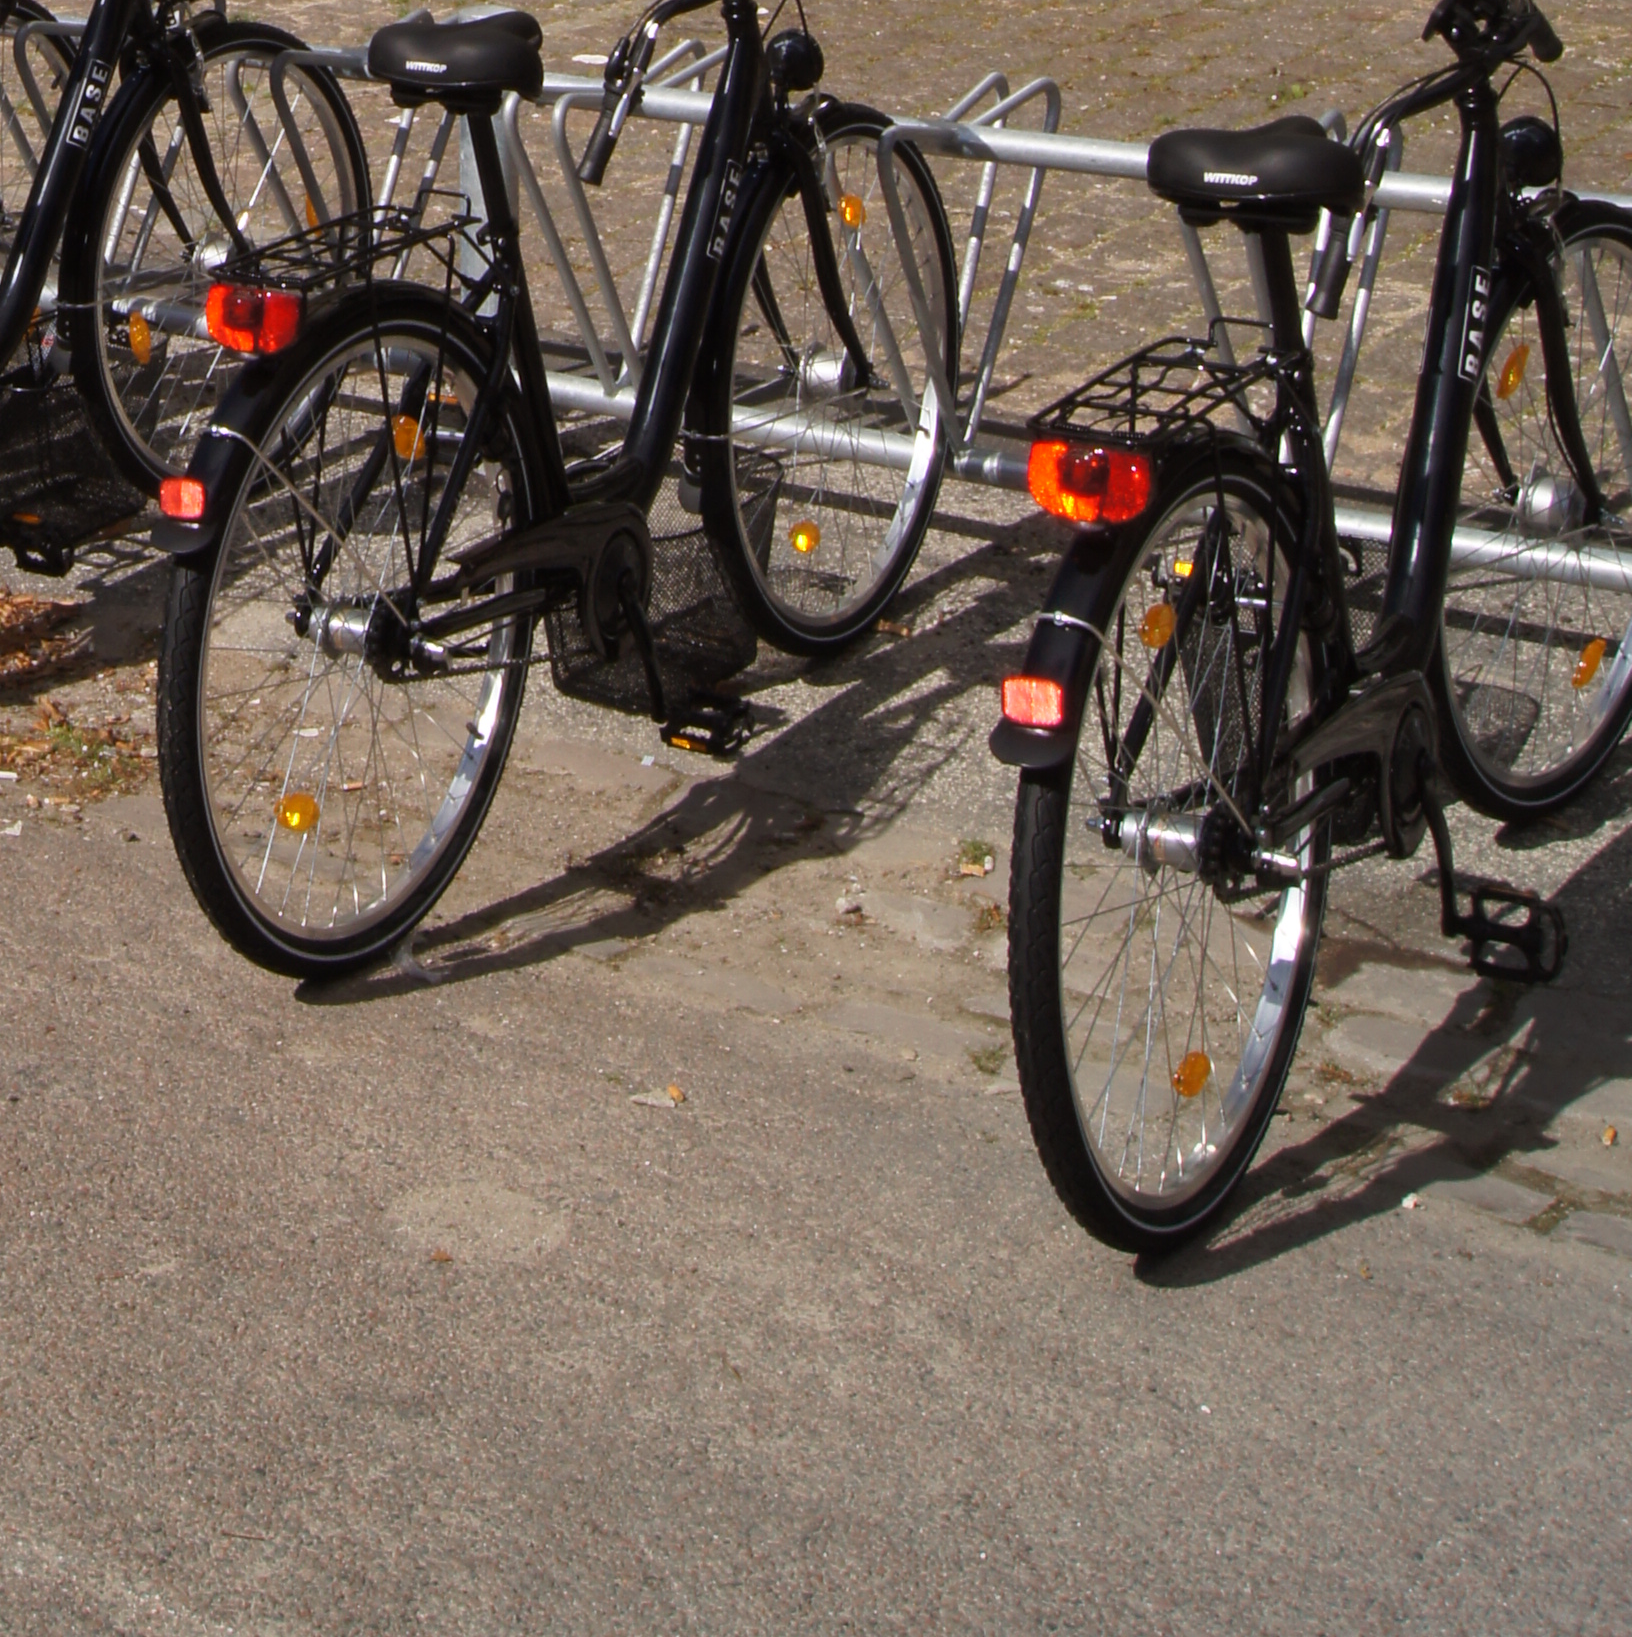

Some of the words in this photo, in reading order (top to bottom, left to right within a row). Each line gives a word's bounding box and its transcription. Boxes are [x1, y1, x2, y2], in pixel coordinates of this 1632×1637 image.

[72, 66, 108, 143] BASE
[1204, 172, 1258, 186] WITTKOP
[1465, 274, 1489, 376] BASE
